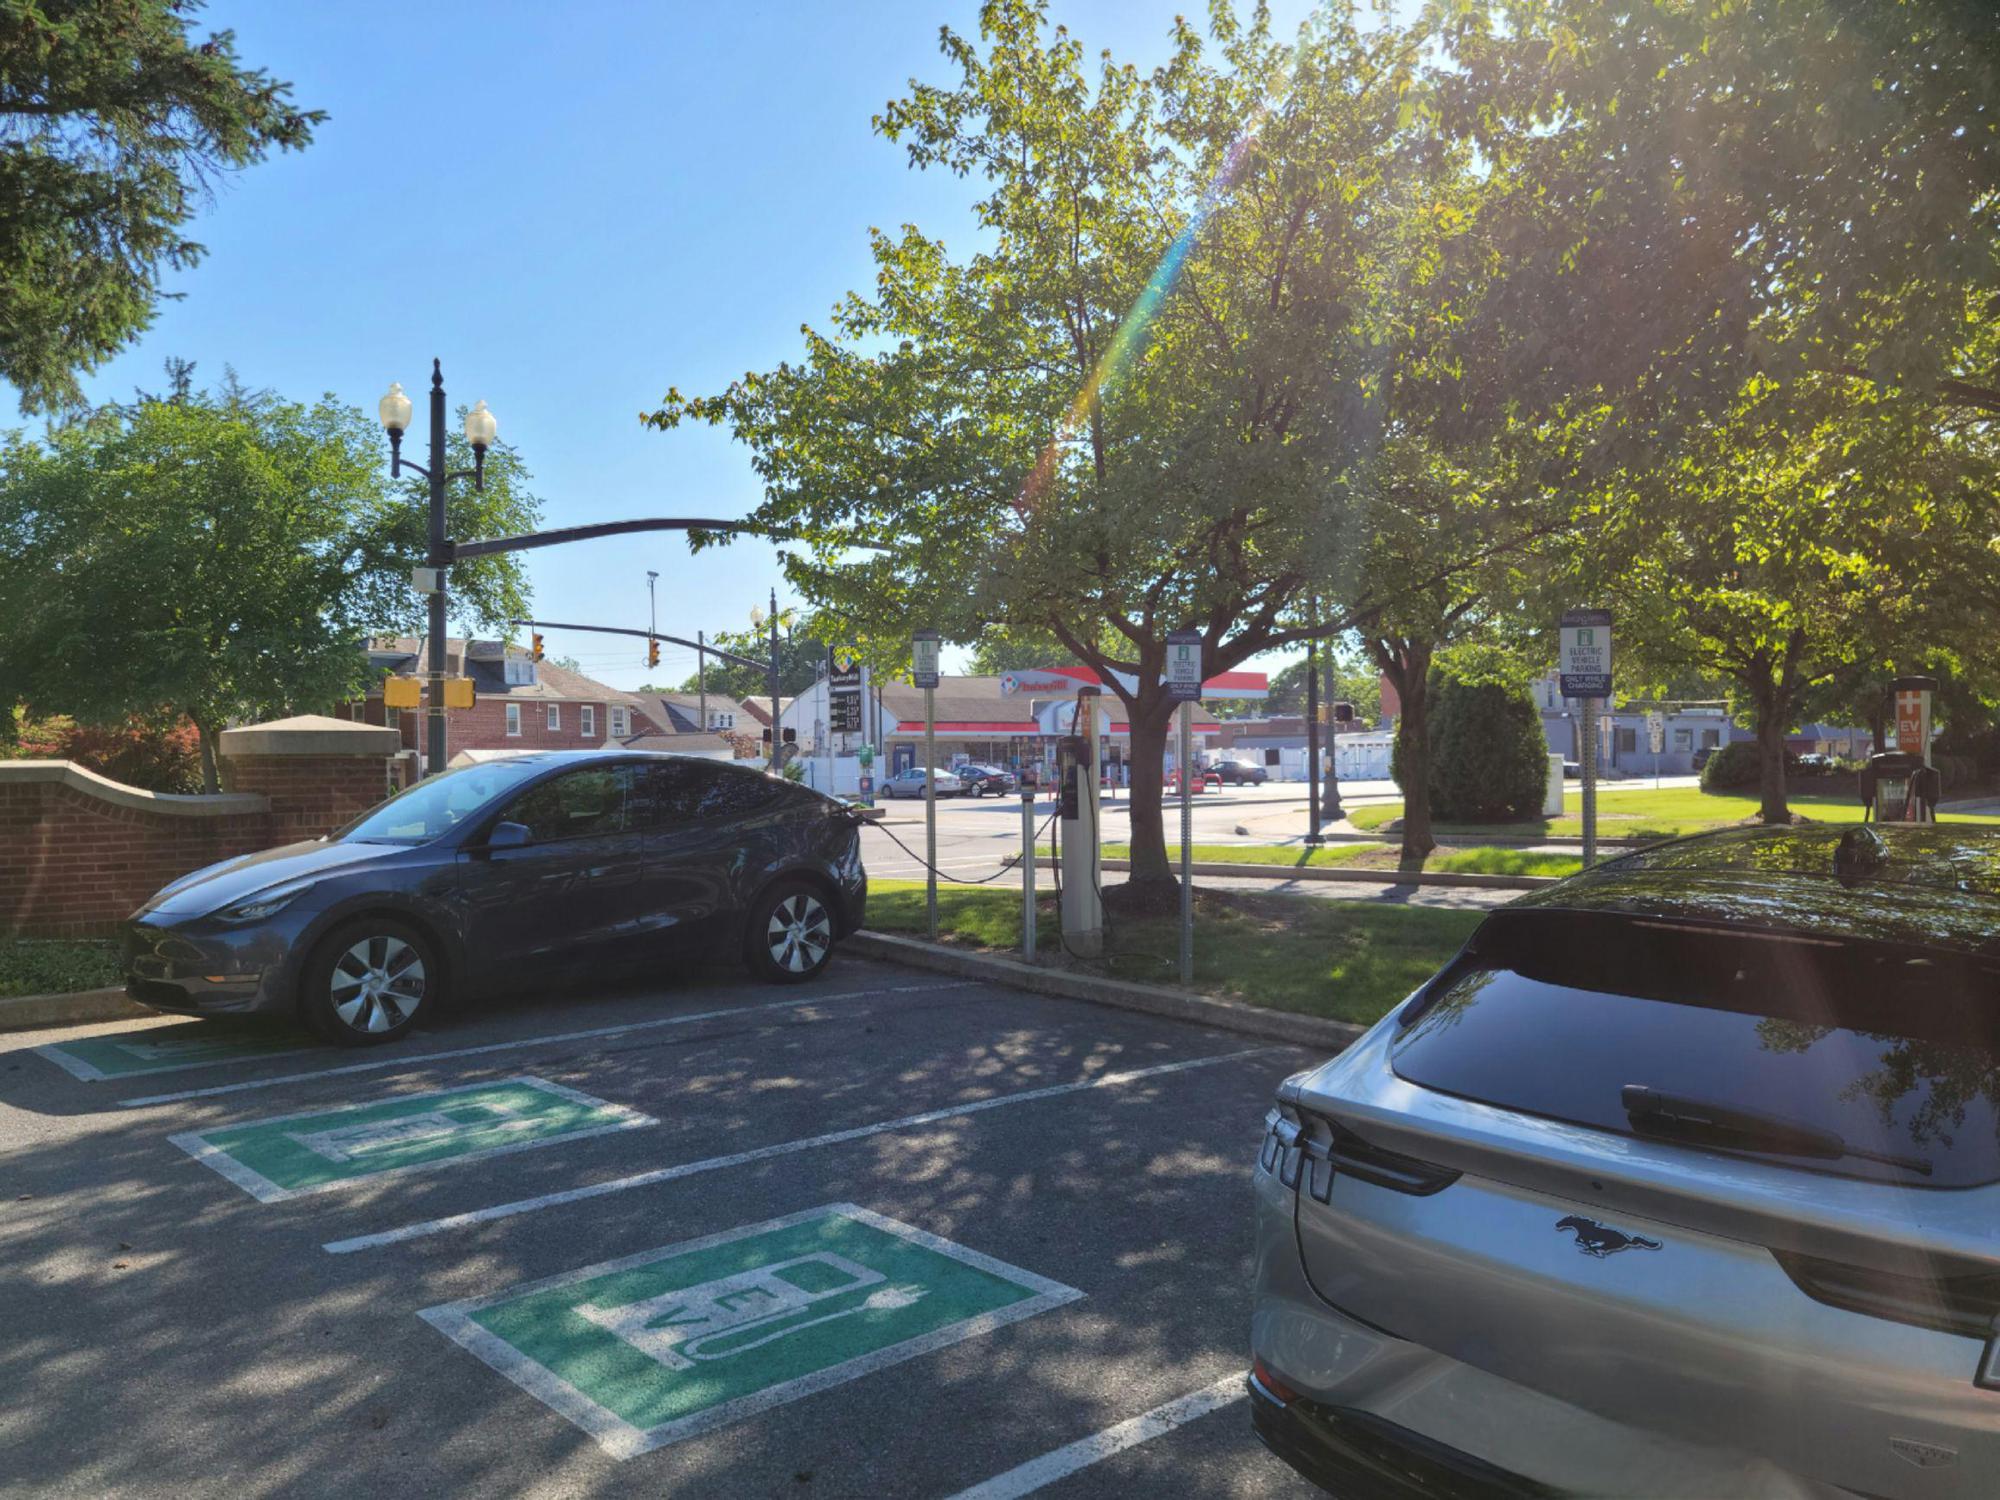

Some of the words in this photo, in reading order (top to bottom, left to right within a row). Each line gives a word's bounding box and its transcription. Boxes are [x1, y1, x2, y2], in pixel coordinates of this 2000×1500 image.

[1569, 647, 1603, 656] ELECTRIC
[1572, 656, 1600, 664] VEHICLE
[1571, 664, 1602, 673] PARKING
[1900, 720, 1920, 732] EV
[1901, 735, 1920, 744] ONLY
